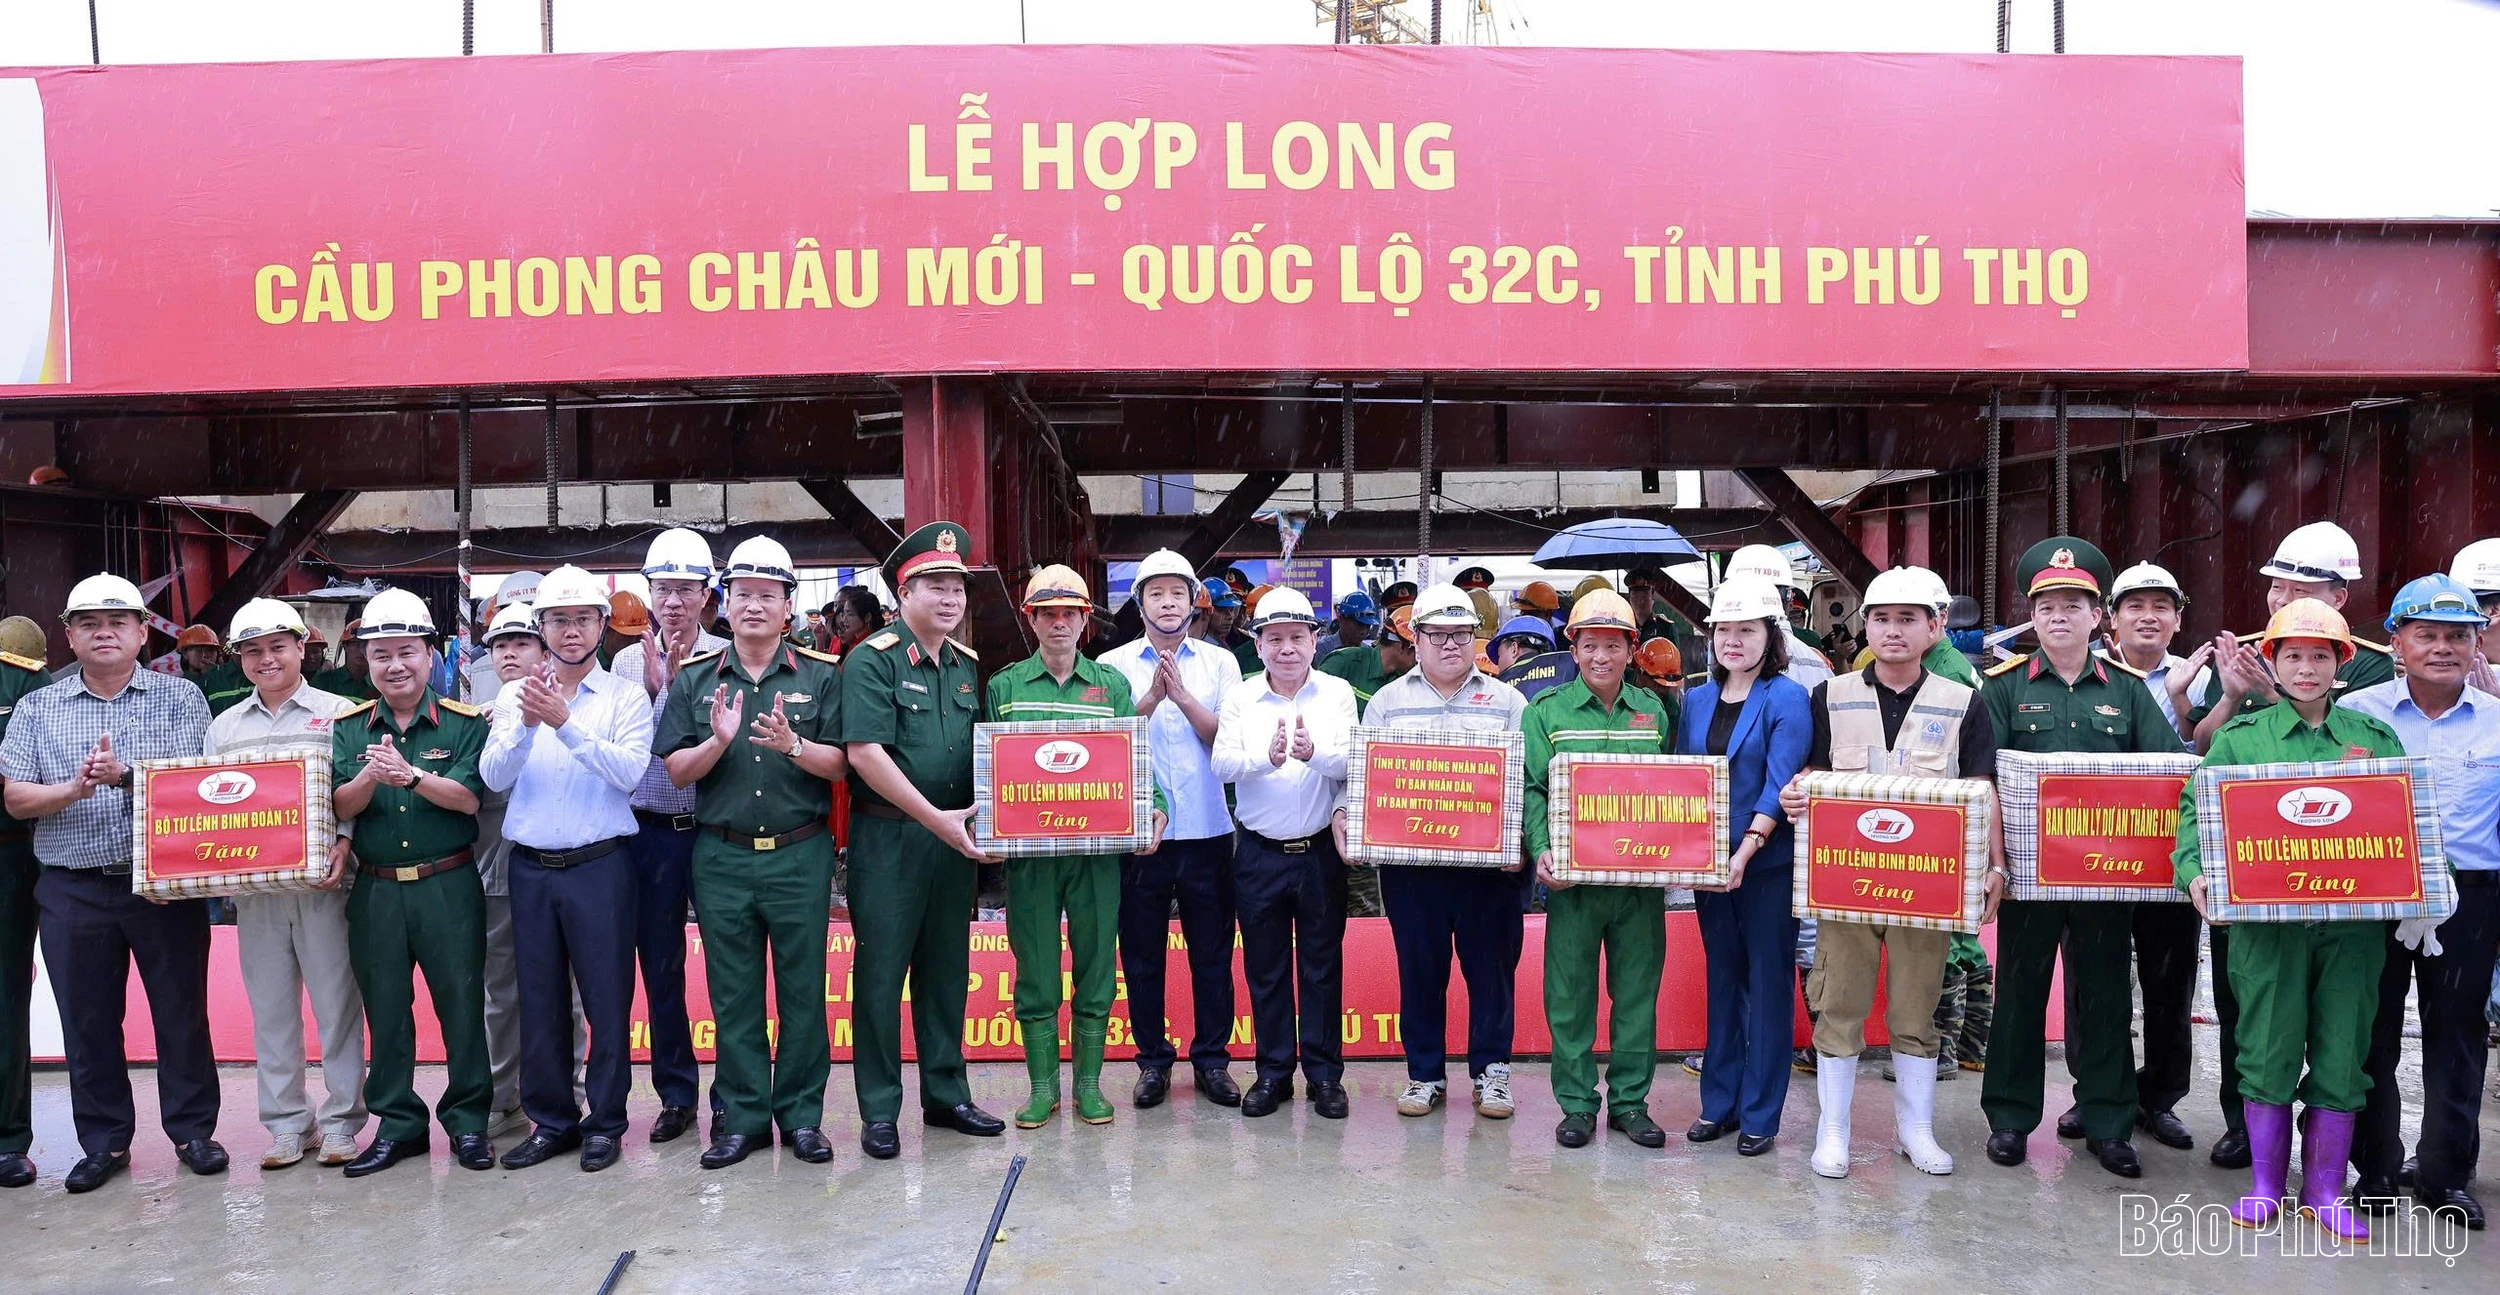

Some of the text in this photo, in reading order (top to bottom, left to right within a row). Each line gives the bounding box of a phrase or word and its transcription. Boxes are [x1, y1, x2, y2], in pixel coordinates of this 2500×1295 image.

[908, 92, 1457, 211] LỄ HỢP LONG
[254, 223, 2090, 325] CẦU PHONG CHÂU MỚI - QUỐC LỘ 32C, TỈNH PHÚ THỌ
[1409, 757, 1424, 773] HỘI
[1452, 760, 1476, 774] NHÂN
[1478, 762, 1499, 776] DÂN,
[1002, 778, 1123, 806] BỘ TƯ LỆNH BINH ĐOÀN 12
[1408, 778, 1426, 791] BAN
[1428, 777, 1452, 792] NHÂN
[1454, 778, 1475, 794] DÂN,
[1390, 797, 1407, 809] BAN
[1410, 798, 1433, 812] MTTQ
[1435, 796, 1455, 812] TỈNH
[1457, 798, 1474, 813] PHÚ
[1476, 802, 1492, 816] THỌ
[1578, 785, 1708, 828] BAN QUẢN LÝ DỰ ÁN THĂNG LONG
[155, 808, 298, 837] BỘ TƯ LỆNH BINH ĐOÀN 12
[1037, 811, 1089, 830] Tặng
[1404, 816, 1461, 838] Tặng
[2046, 797, 2180, 842] BAN QUẢN LÝ DỰ ÁN THĂNG LON
[195, 842, 260, 862] Tặng
[1613, 838, 1671, 859] Tặng
[1816, 845, 1956, 874] BỘ TƯ LỆNH BINH ĐOÀN 12
[2236, 831, 2405, 867] BỘ TƯ LỆNH BINH ĐOÀN 12
[2083, 853, 2145, 876] Tặng
[1852, 878, 1915, 904] Tặng
[2286, 871, 2358, 895] Tặng
